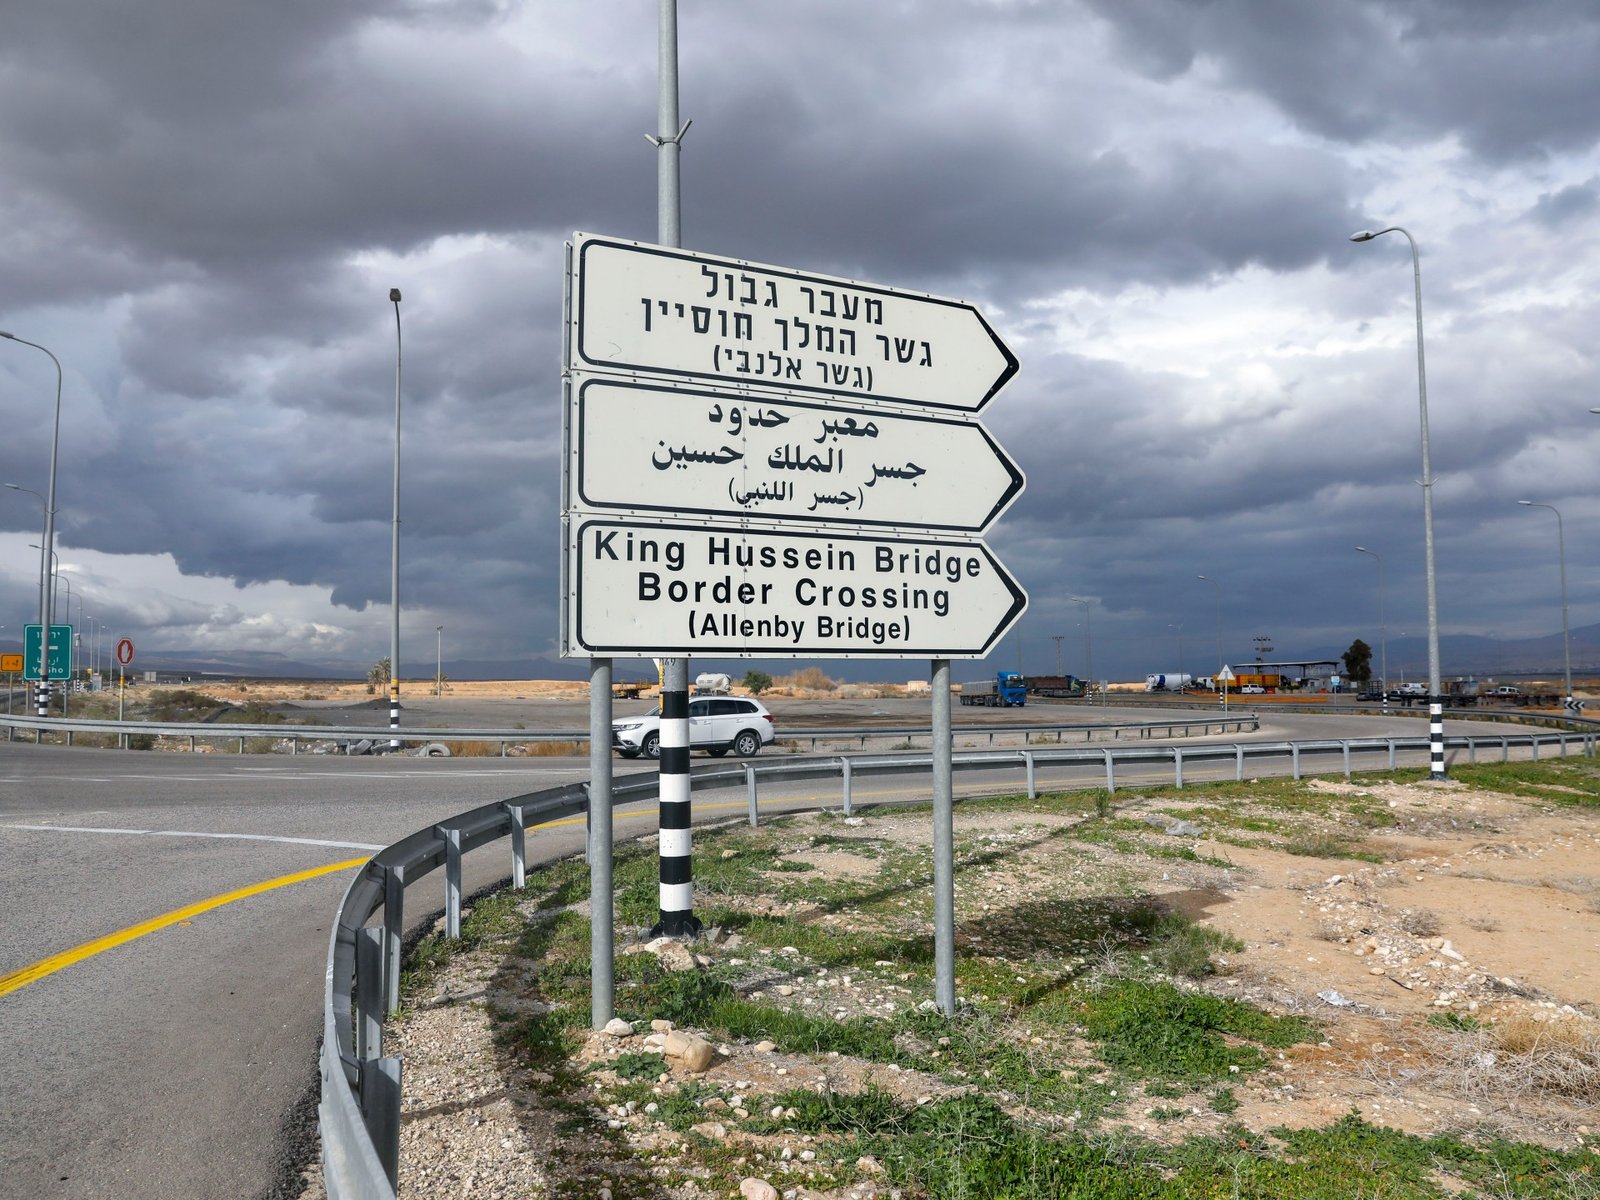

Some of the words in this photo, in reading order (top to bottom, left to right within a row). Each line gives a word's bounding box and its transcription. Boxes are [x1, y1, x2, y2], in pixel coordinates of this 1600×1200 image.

[701, 264, 778, 308] גבול
[641, 298, 753, 341] חוסיין
[800, 286, 883, 325] מעבר
[774, 316, 856, 356] המלך
[875, 334, 933, 367] גשר
[713, 344, 802, 380] אלנבי)
[816, 361, 873, 391] (גשר
[708, 403, 790, 436] حدود
[813, 416, 880, 443] معبر
[651, 440, 745, 471] حسين
[767, 443, 843, 474] الملك
[863, 461, 927, 487] جسر
[807, 486, 864, 511] (جسر
[595, 530, 685, 571] King
[708, 536, 855, 569] Hussein
[875, 545, 981, 582] Bridge
[638, 571, 773, 604] Border
[795, 577, 949, 616] Crossing
[688, 610, 805, 643] (Allenby
[817, 614, 910, 644] Bridge)
